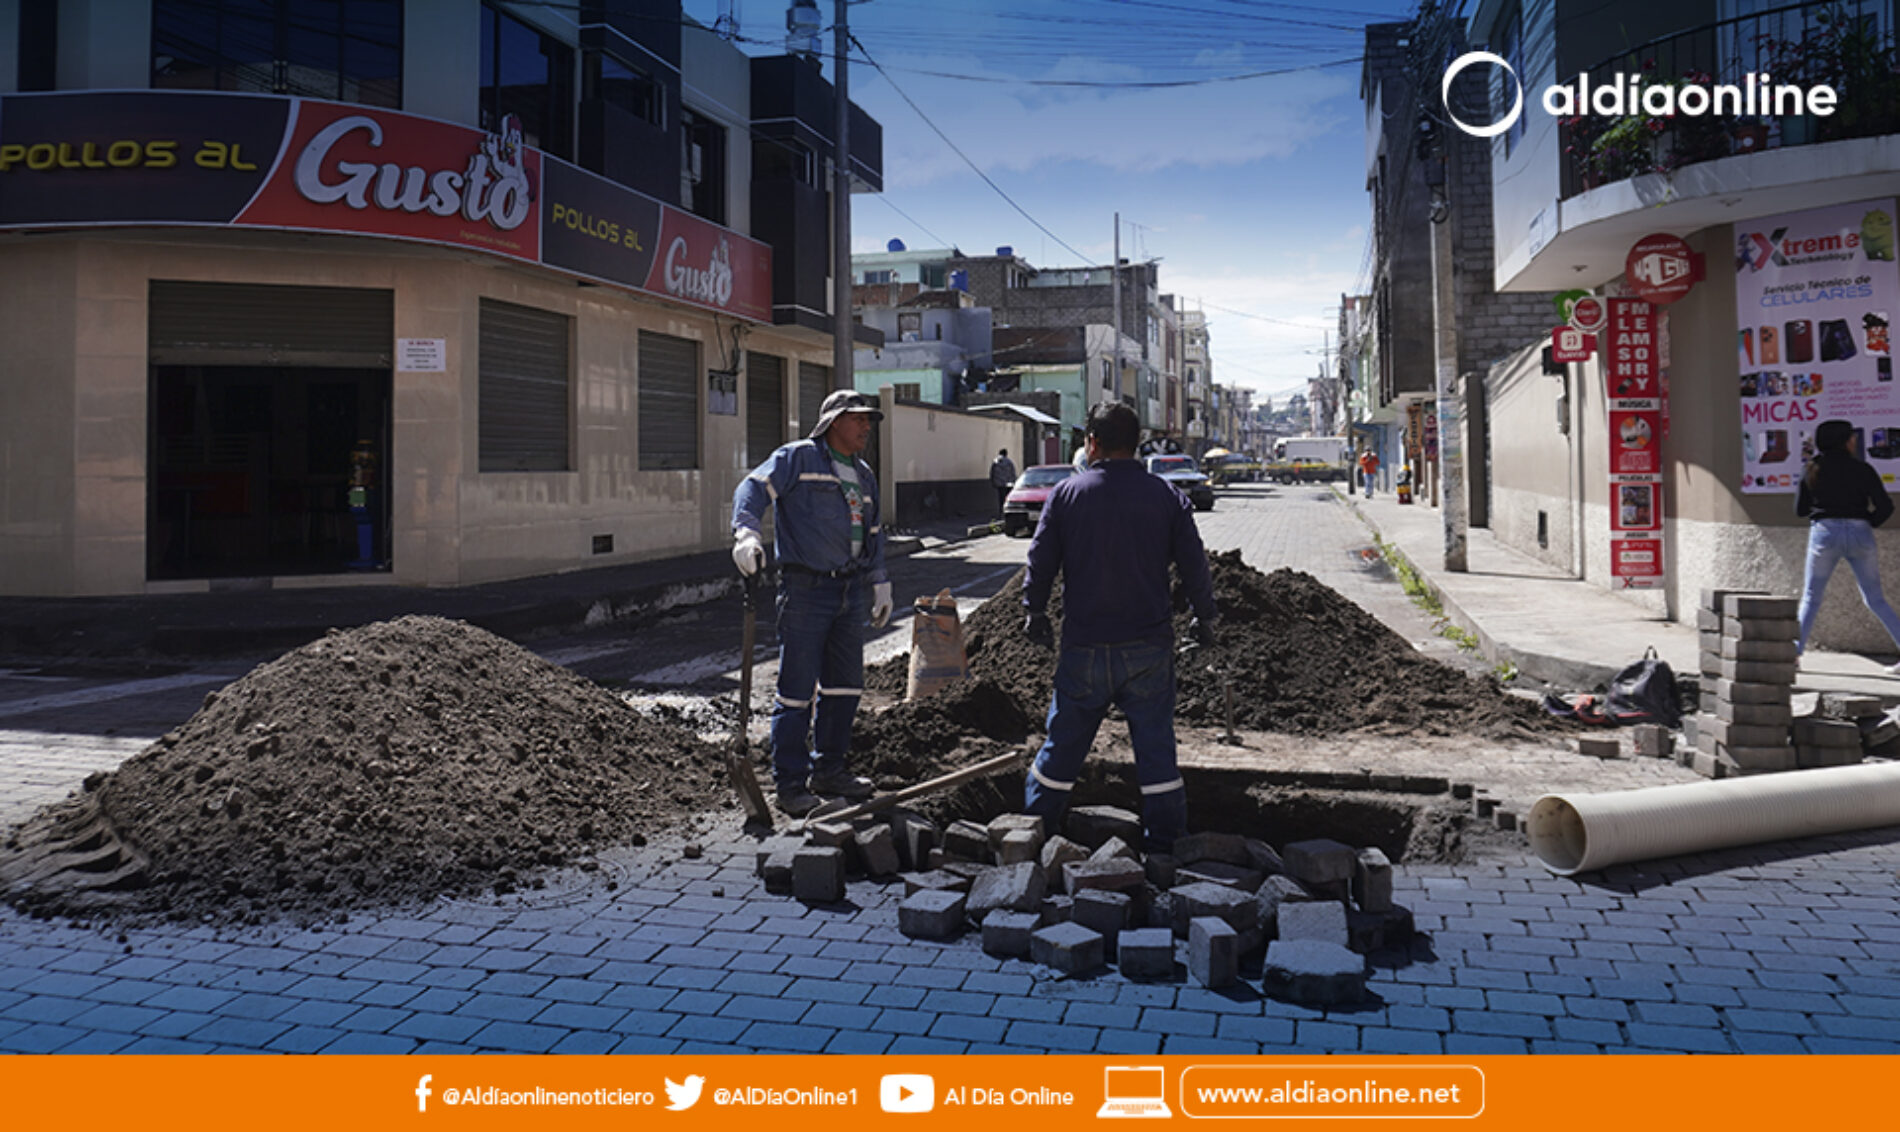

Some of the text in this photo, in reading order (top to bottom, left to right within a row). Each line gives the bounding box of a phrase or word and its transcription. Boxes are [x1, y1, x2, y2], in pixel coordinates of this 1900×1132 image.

[0, 140, 178, 171] POLLOS
[294, 115, 531, 230] Gusto
[552, 203, 620, 244] POLLOS
[1751, 226, 1861, 271] Xtreme
[1790, 252, 1855, 265] Technology
[664, 236, 733, 307] Gusto
[1762, 274, 1872, 295] Servicio Técnico de
[1760, 285, 1873, 307] CELULARES
[1616, 302, 1632, 375] FLASH
[1631, 302, 1651, 391] MEMORY
[1743, 399, 1819, 424] MICAS
